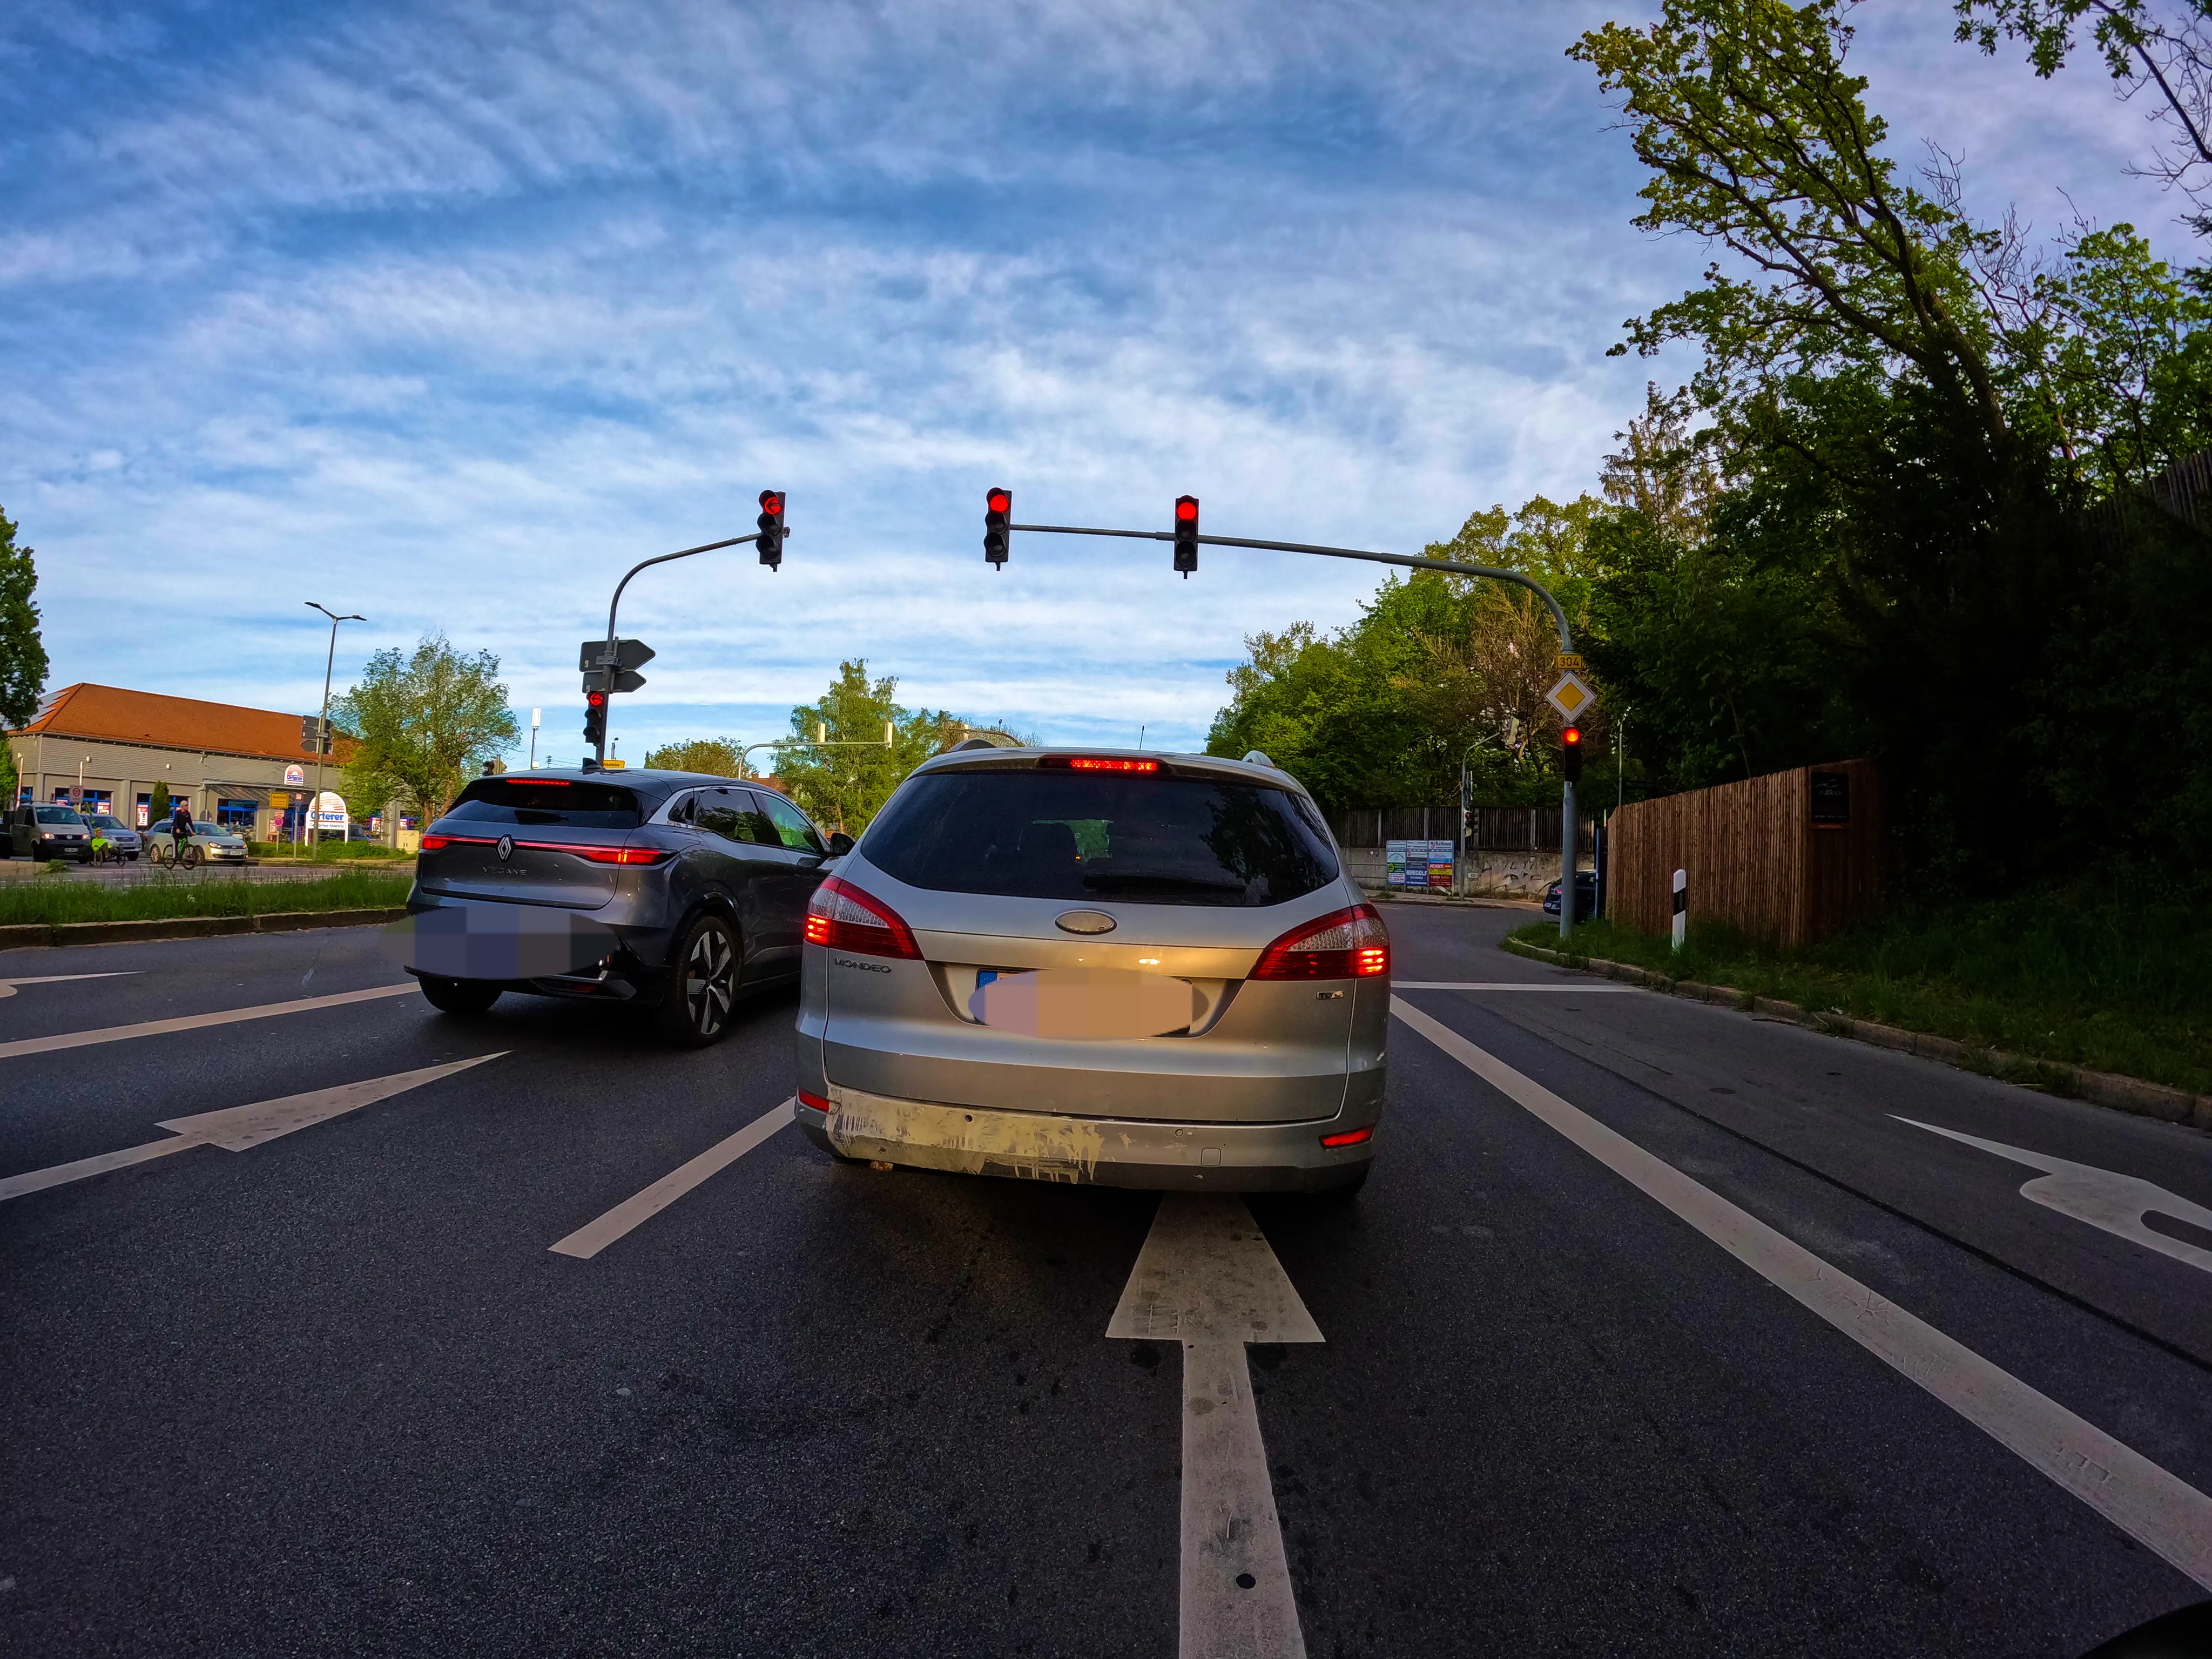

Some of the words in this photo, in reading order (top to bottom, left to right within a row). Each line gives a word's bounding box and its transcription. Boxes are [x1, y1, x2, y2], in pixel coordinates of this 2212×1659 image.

[1560, 657, 1579, 666] 304
[311, 811, 344, 820] Orterer
[834, 957, 892, 973] MONDEO
